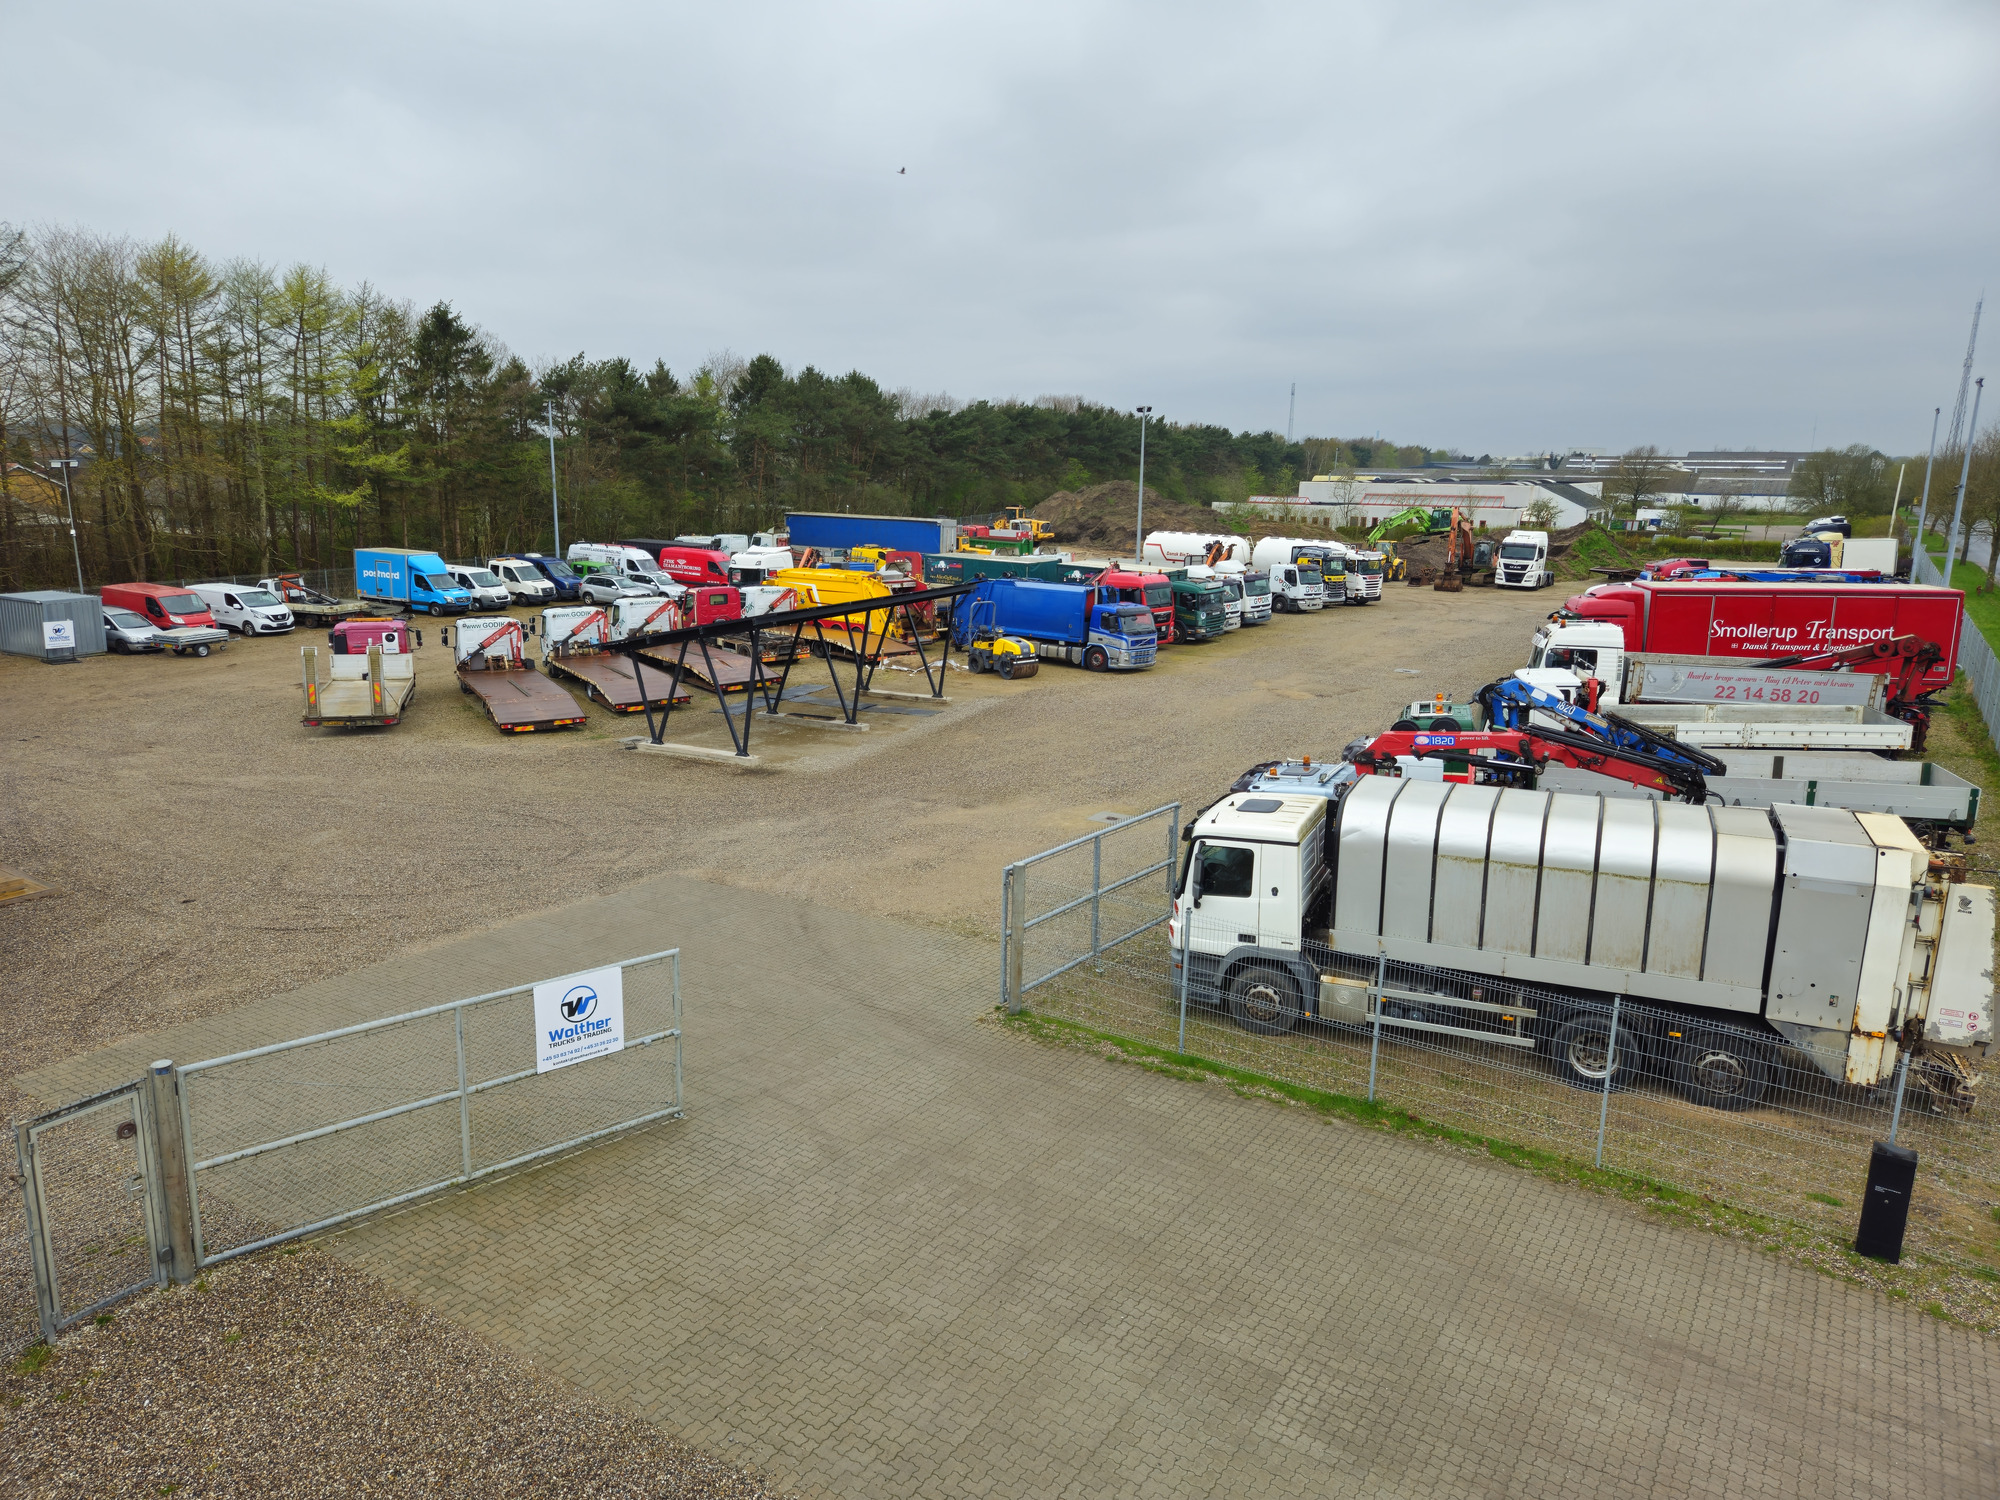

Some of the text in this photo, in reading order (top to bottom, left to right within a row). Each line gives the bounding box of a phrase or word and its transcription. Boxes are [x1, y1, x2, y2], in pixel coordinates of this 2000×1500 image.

[363, 569, 400, 580] postnord
[1710, 619, 1894, 643] Smollerup Transport
[1742, 642, 1769, 650] Dansk
[1771, 643, 1812, 652] Transport
[1765, 675, 1780, 686] Ring
[1714, 685, 1820, 704] 22 14 58 20
[1556, 700, 1576, 715] 1820
[1431, 736, 1455, 746] 1820
[548, 1037, 576, 1049] TRUCKS
[583, 1027, 613, 1039] TRADING
